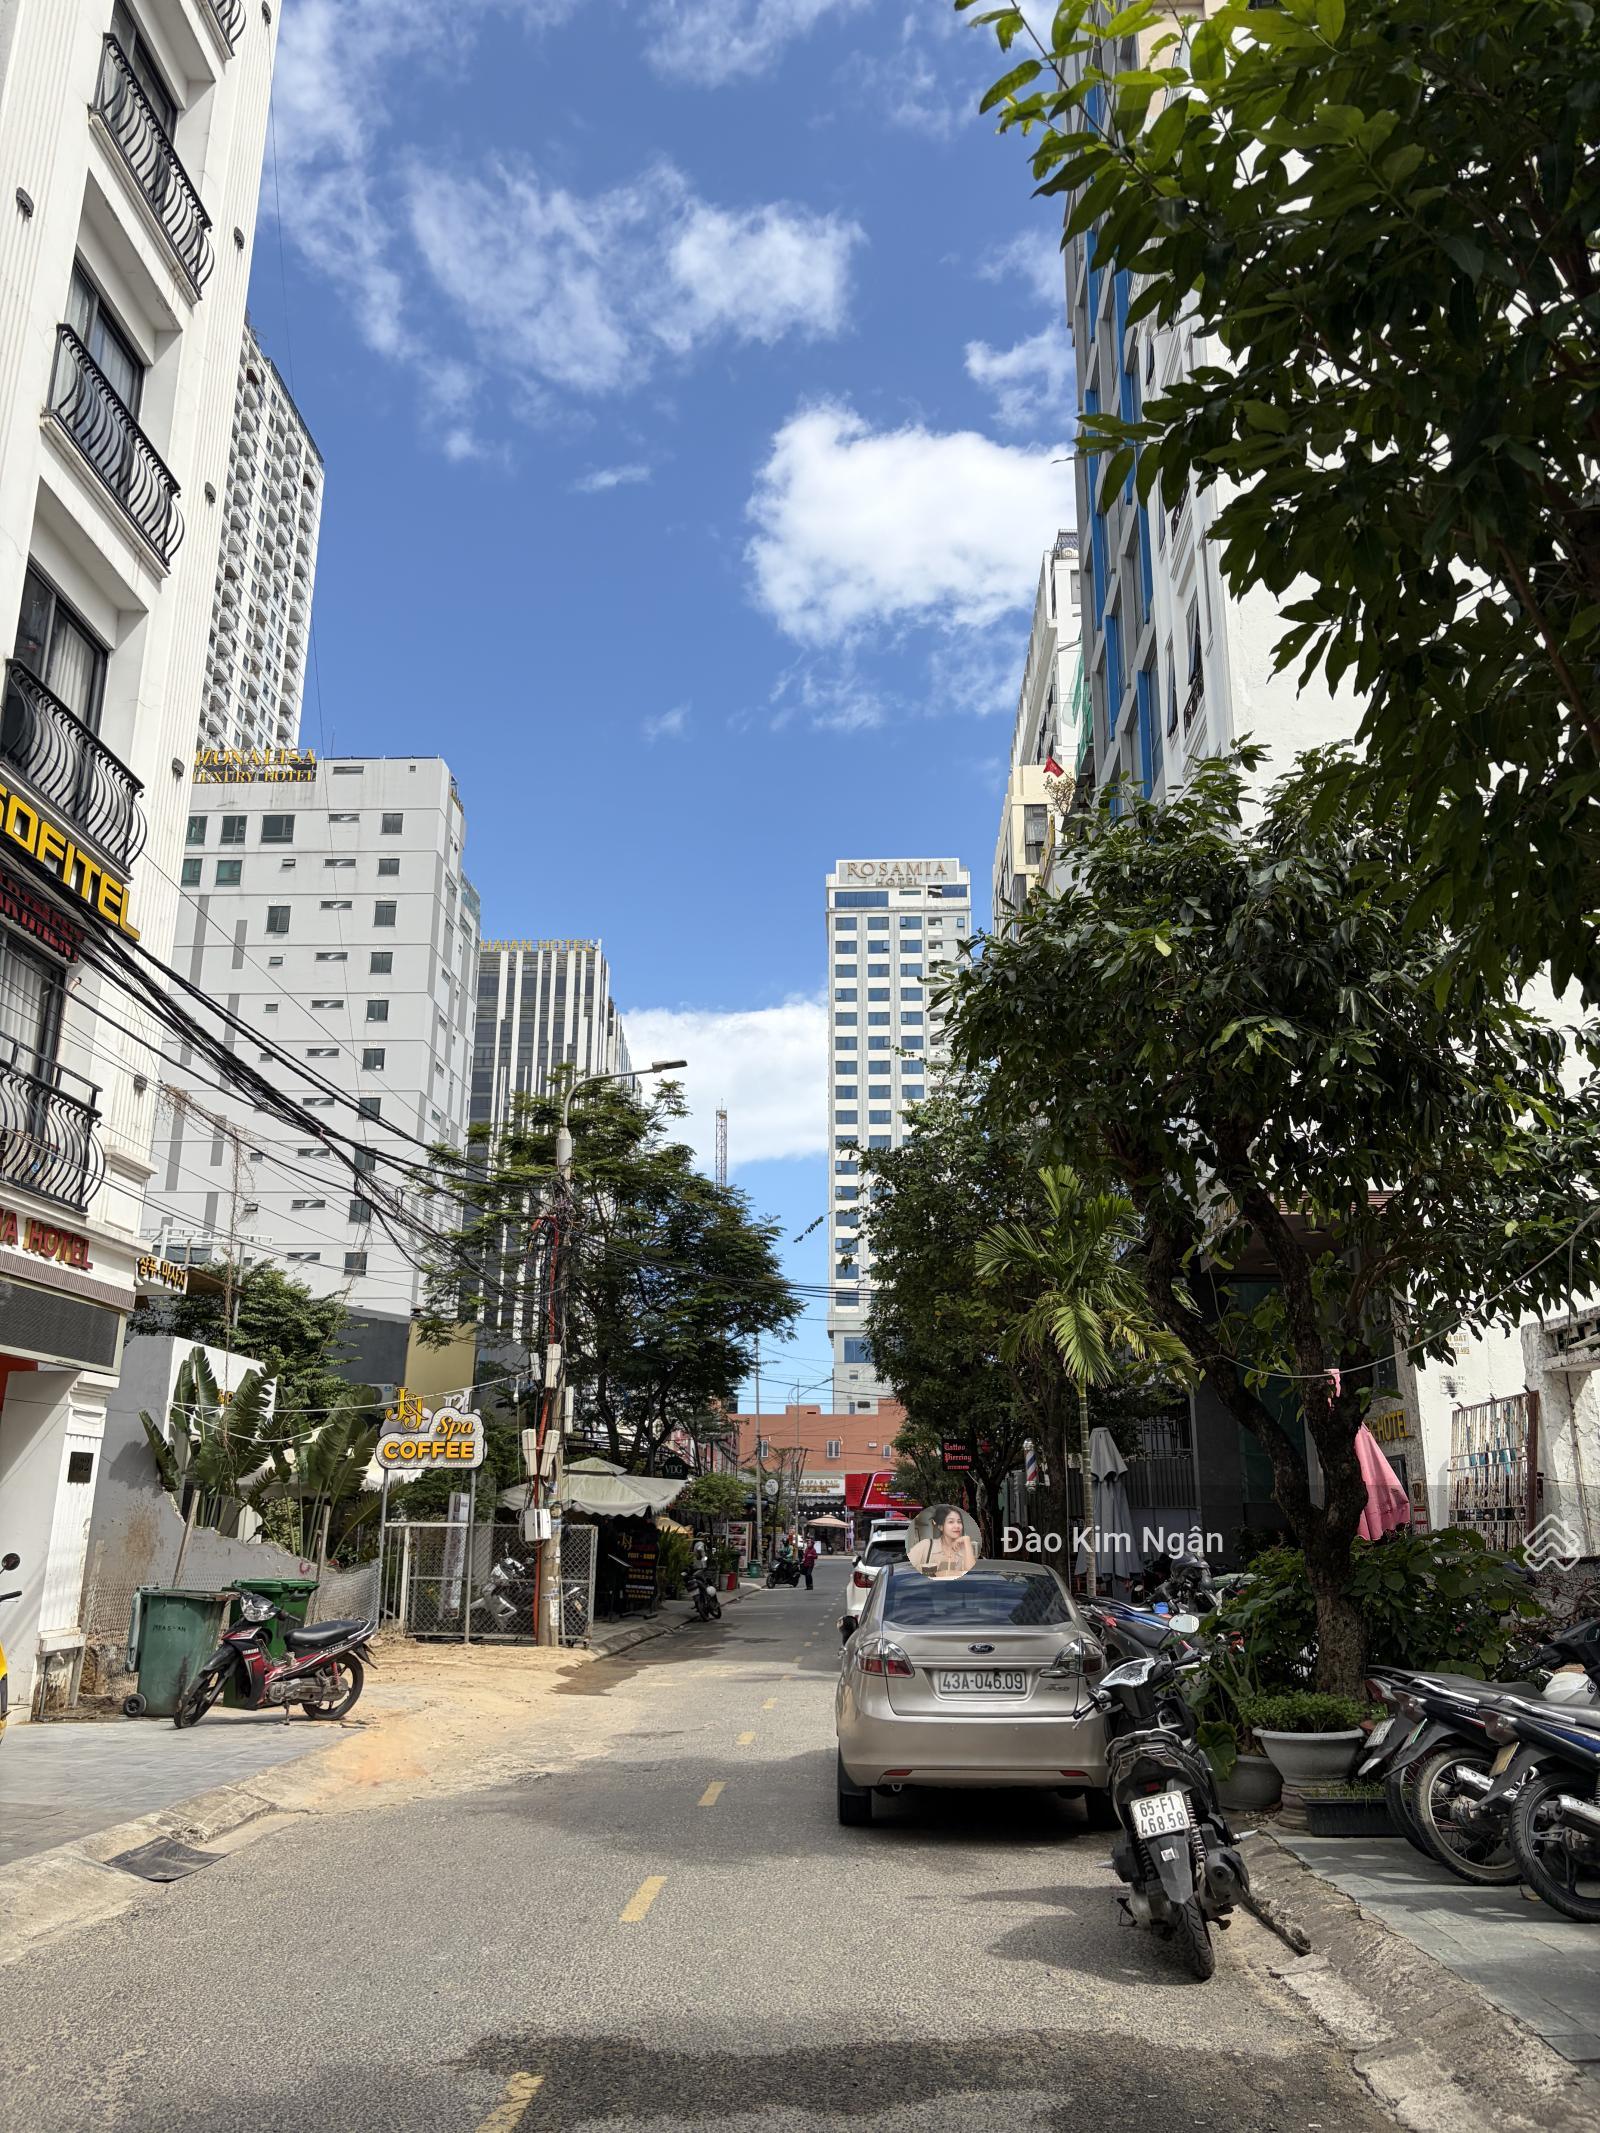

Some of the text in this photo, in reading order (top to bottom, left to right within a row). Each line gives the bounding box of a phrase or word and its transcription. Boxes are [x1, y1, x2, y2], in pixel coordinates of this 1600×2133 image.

[264, 769, 317, 782] HOTEL
[0, 783, 140, 942] OFITEL
[847, 862, 948, 879] ROSAMIA
[24, 1217, 94, 1271] HOTEL
[435, 1415, 476, 1442] Spa
[1376, 1409, 1409, 1441] HOTEL
[383, 1440, 476, 1460] COFFEE
[665, 1464, 683, 1474] VDG
[942, 1672, 1024, 1691] 43A-046.09
[1139, 1795, 1175, 1818] 65-F1
[1140, 1810, 1186, 1835] 468.58
